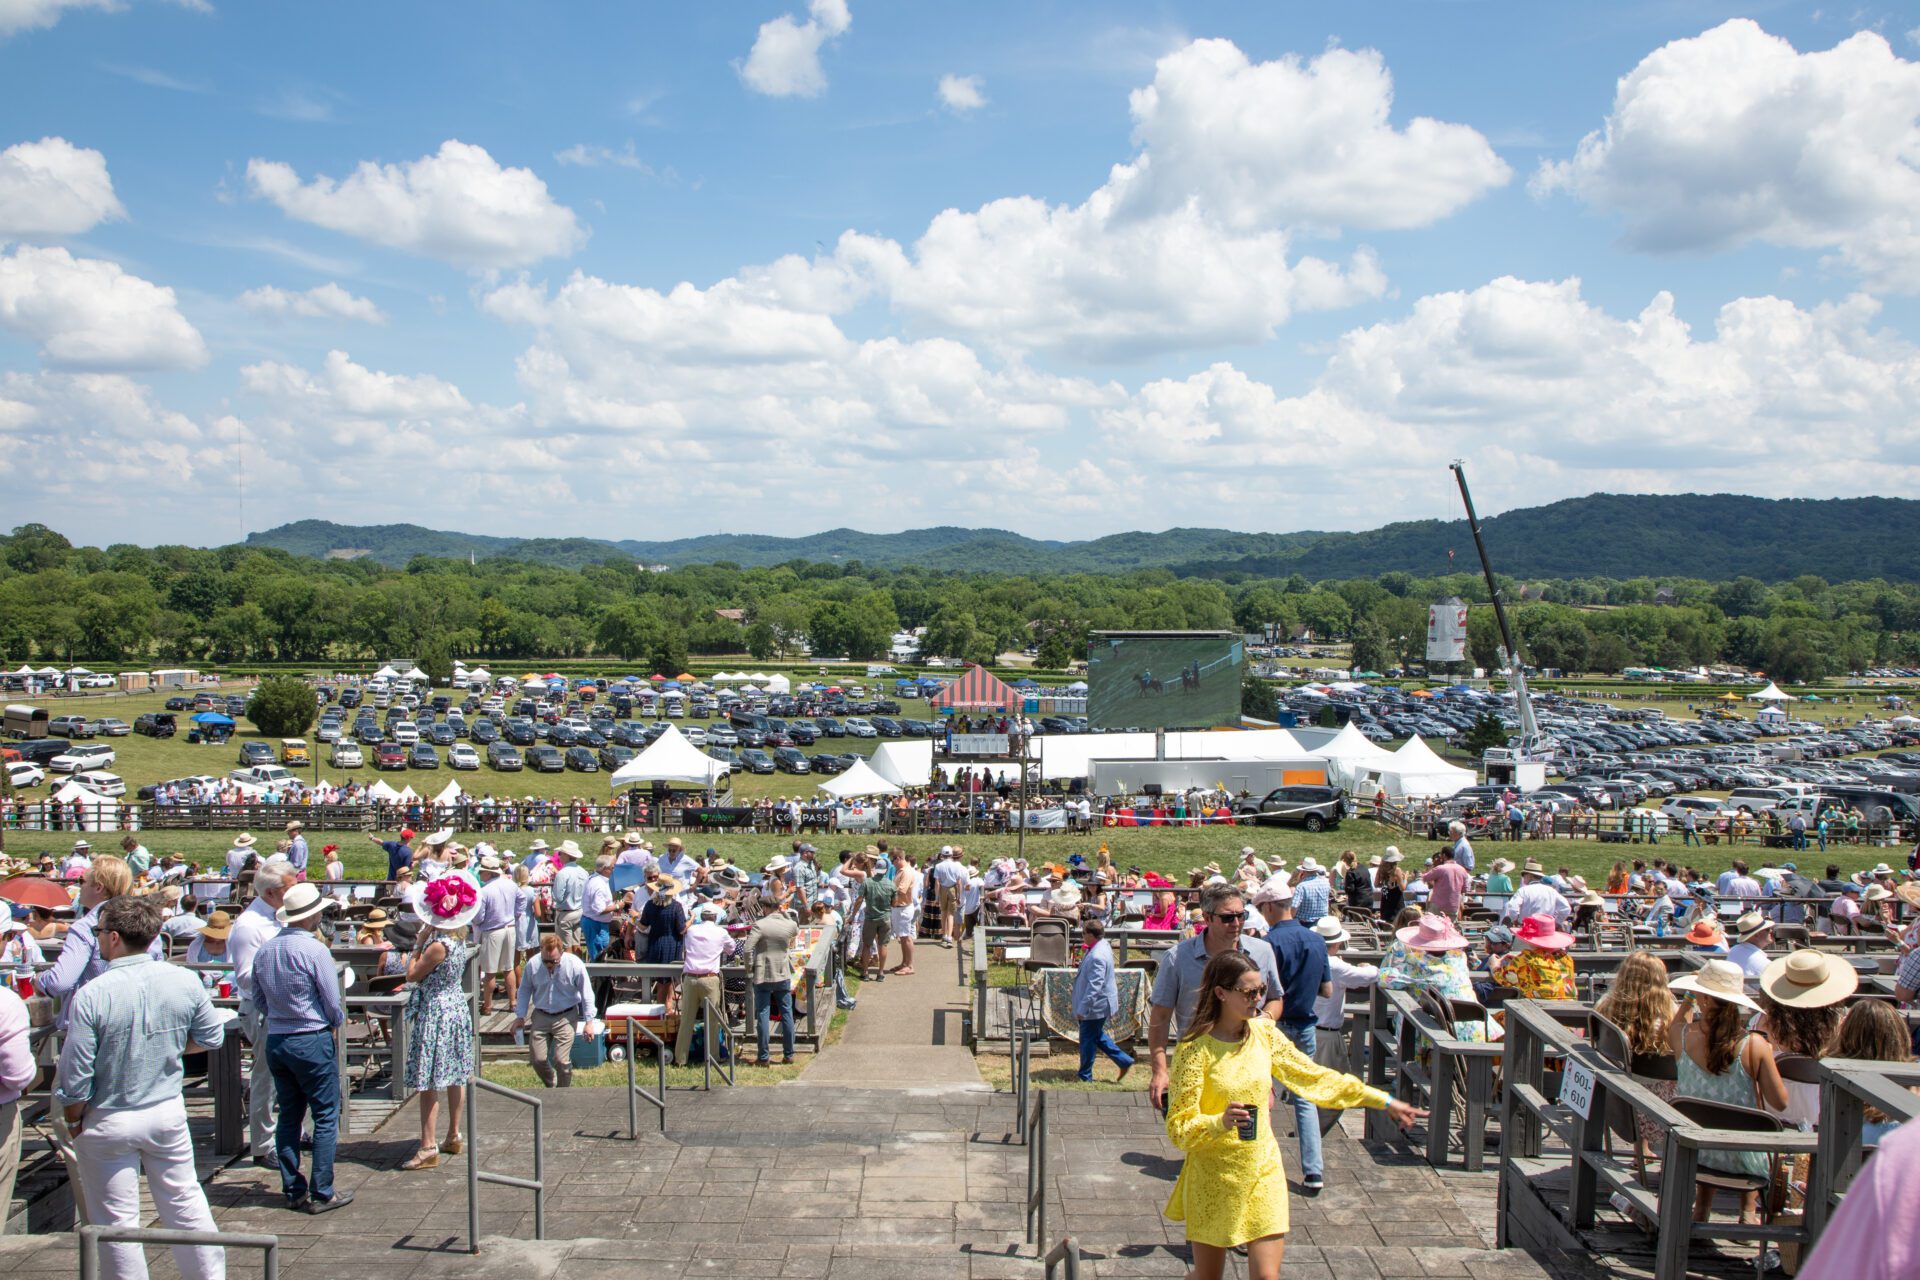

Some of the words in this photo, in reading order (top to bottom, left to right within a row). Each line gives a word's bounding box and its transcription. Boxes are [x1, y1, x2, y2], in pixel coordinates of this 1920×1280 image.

[954, 744, 959, 752] 3
[776, 813, 829, 822] COPASS
[1574, 1071, 1592, 1091] 601-
[1570, 1090, 1586, 1109] 610
